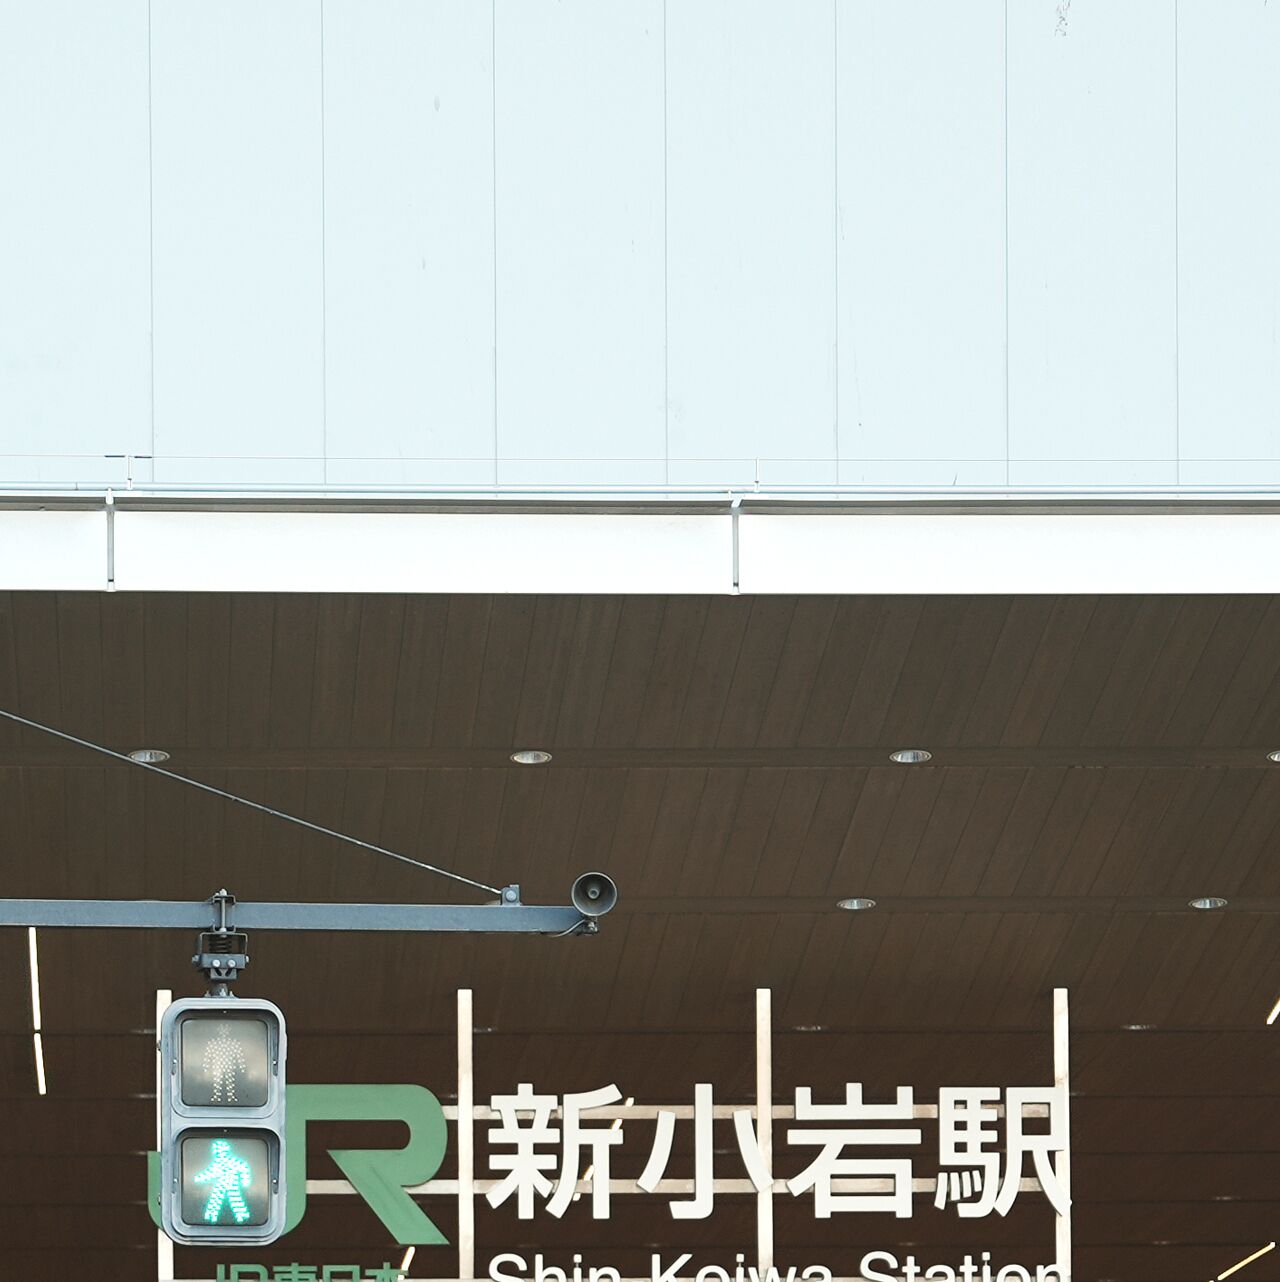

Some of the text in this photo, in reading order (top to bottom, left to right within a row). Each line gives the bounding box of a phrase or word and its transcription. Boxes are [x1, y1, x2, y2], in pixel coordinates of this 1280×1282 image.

[148, 1084, 449, 1245] R
[486, 1083, 1072, 1219] 新小岩駅
